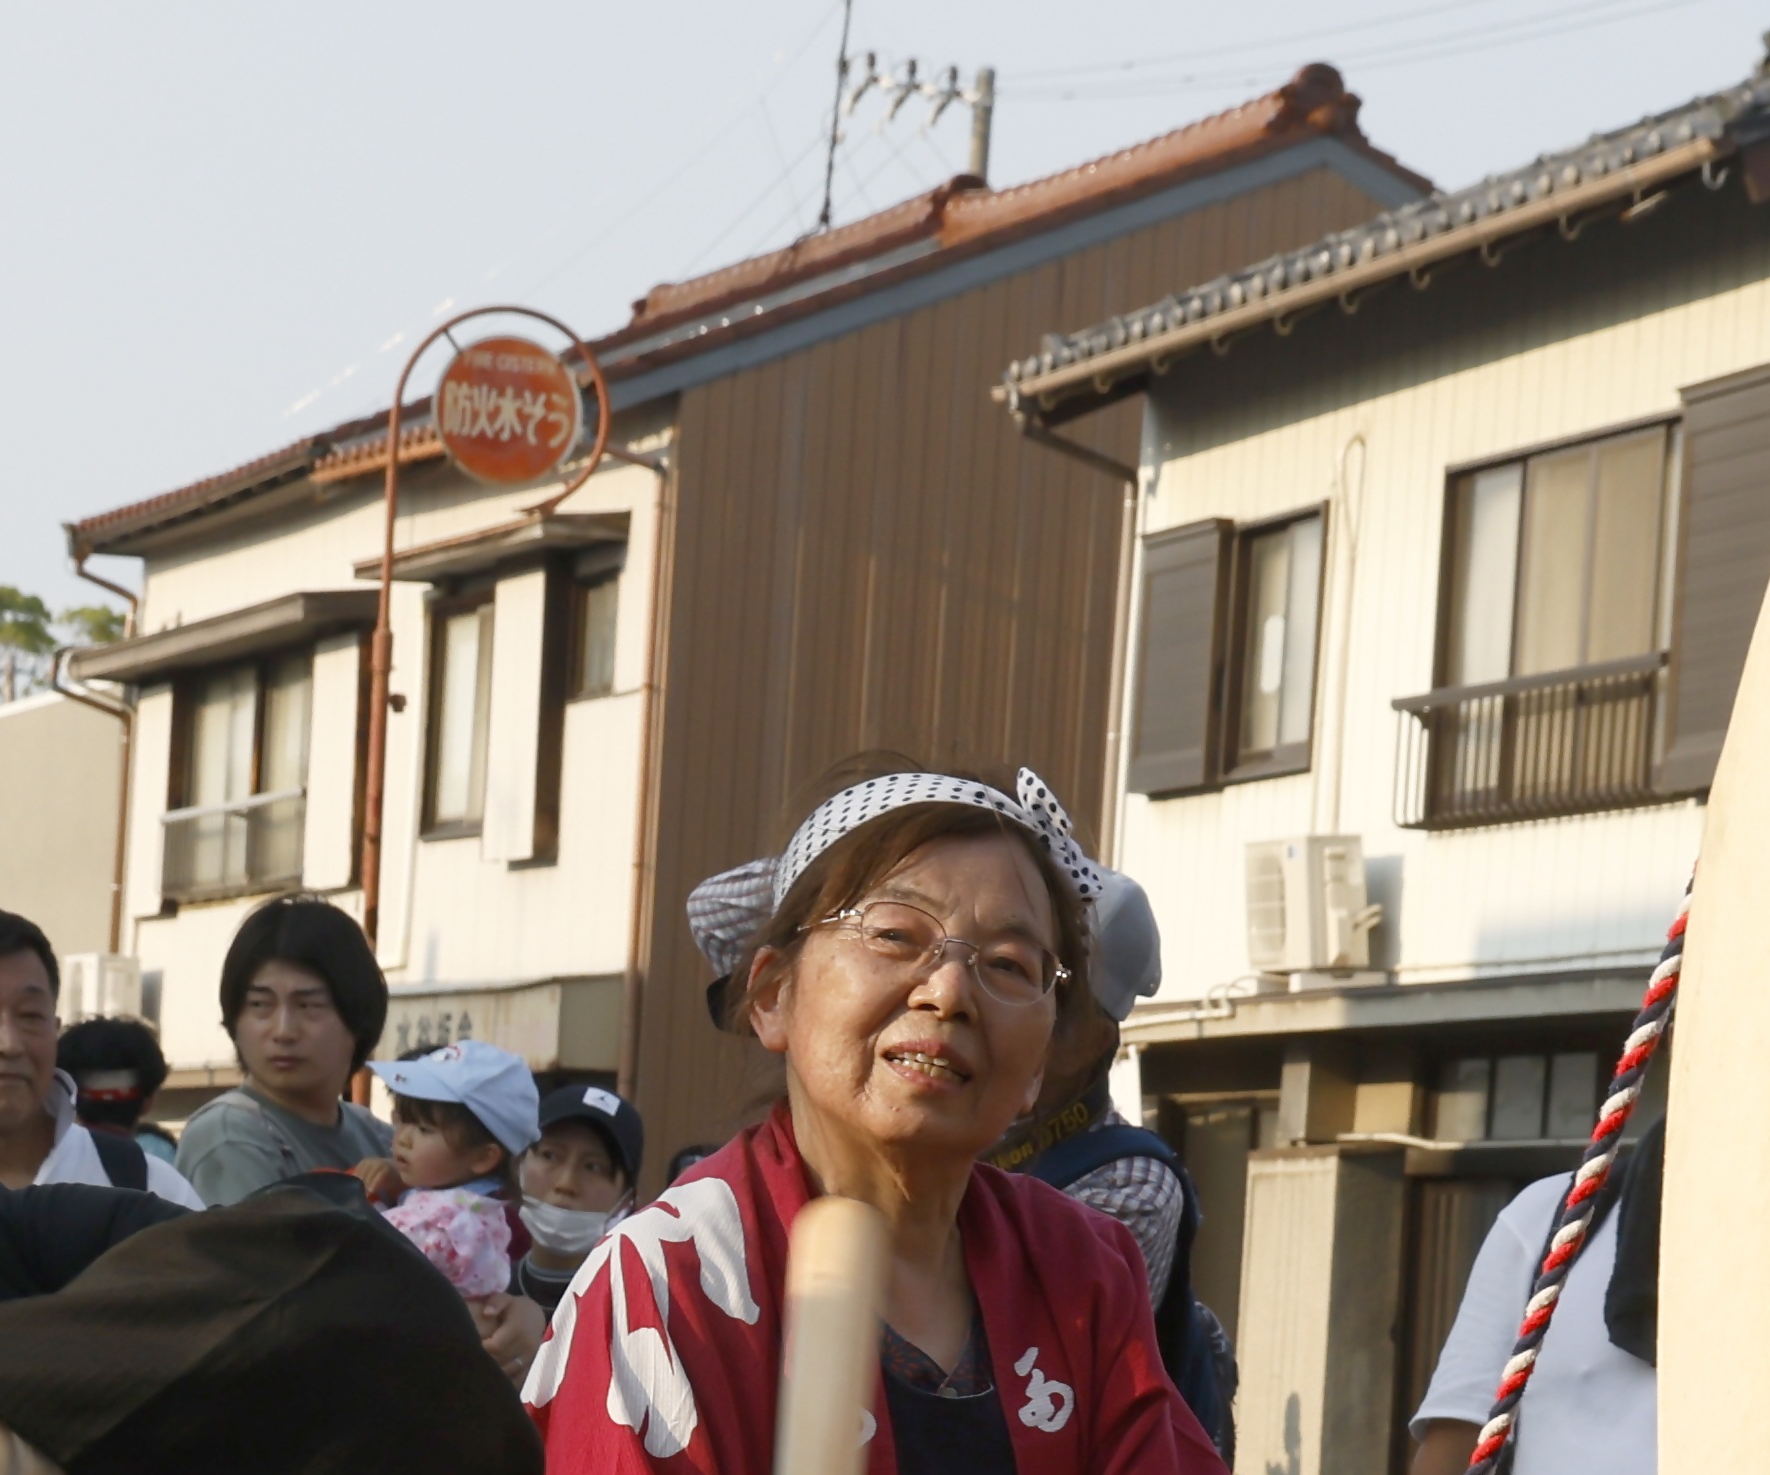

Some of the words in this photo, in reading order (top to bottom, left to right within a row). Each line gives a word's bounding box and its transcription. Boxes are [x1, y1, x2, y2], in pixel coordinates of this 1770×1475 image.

[444, 379, 571, 449] 防火水そう
